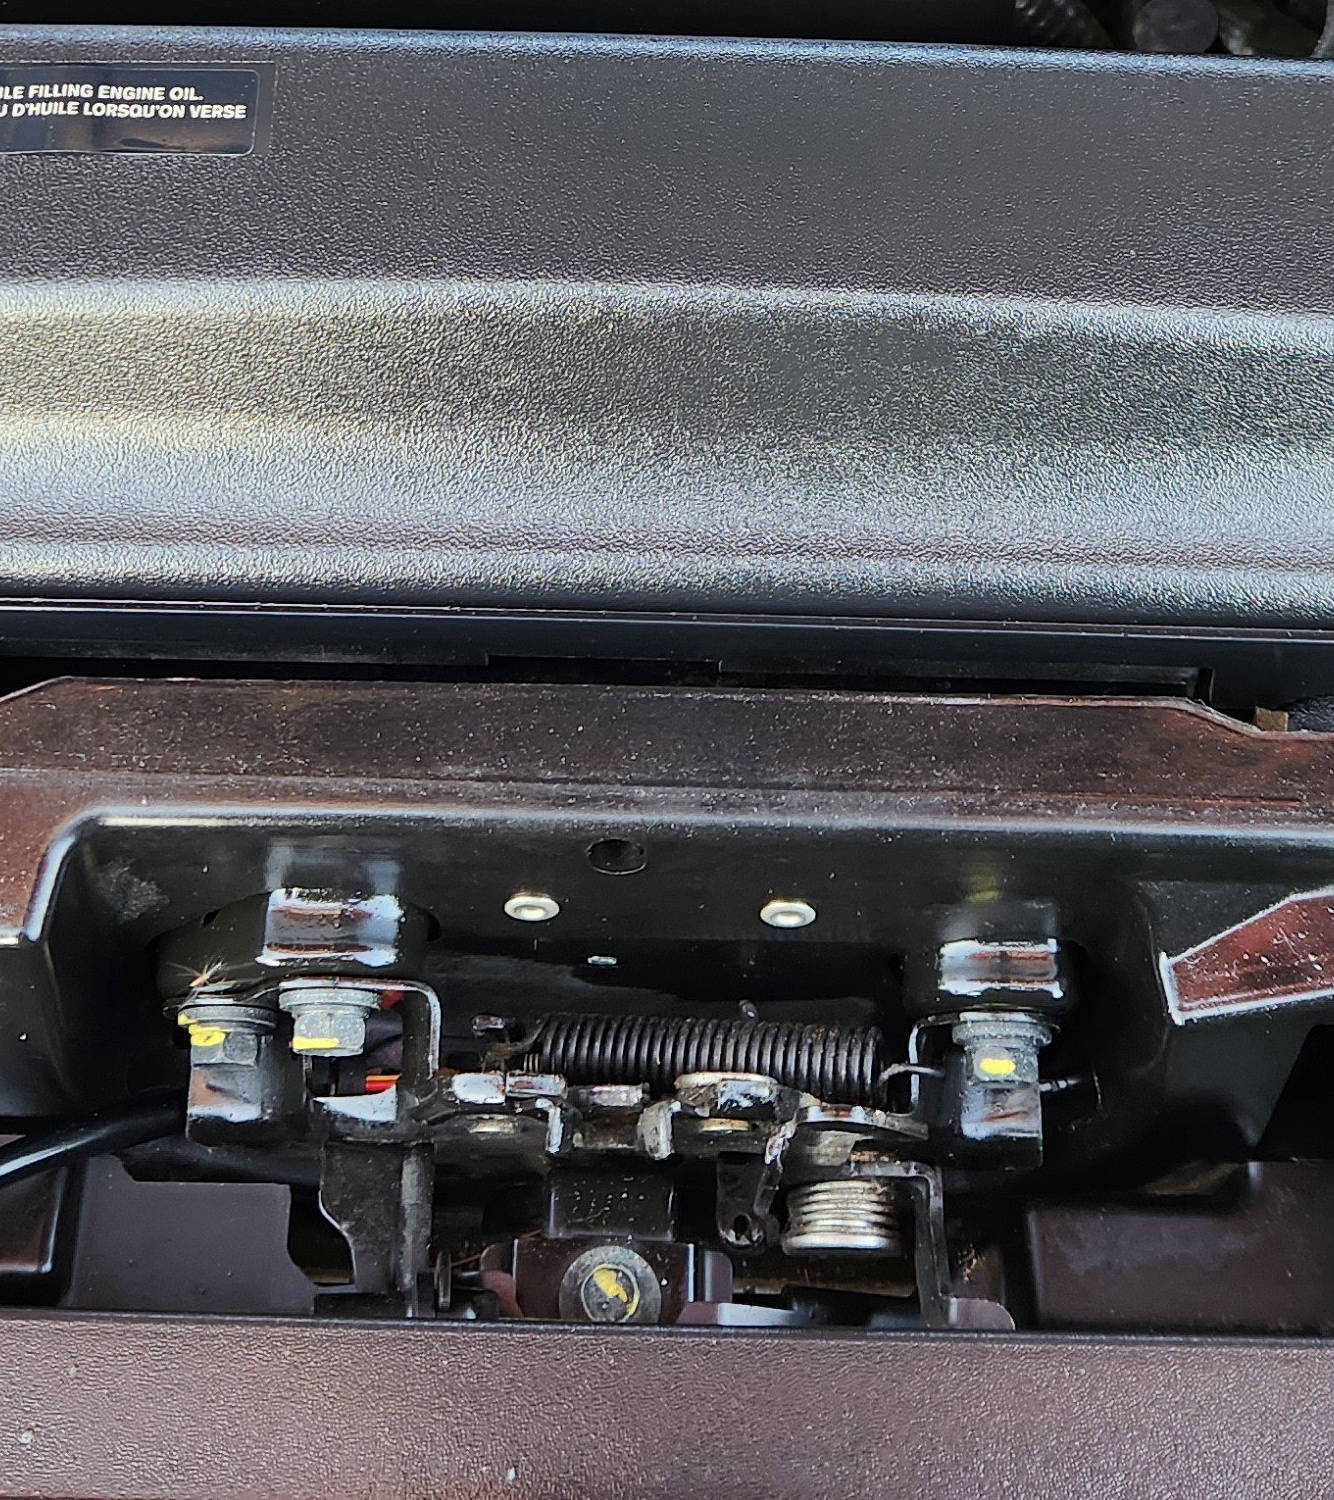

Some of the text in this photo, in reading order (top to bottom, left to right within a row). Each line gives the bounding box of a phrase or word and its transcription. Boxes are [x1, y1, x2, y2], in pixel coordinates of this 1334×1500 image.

[28, 83, 94, 99] FILLING
[97, 85, 165, 101] ENGINE
[169, 86, 204, 101] OIL.
[12, 101, 79, 117] D'HUILE
[82, 102, 185, 118] LORSQU'ON
[189, 103, 247, 119] VERSE
